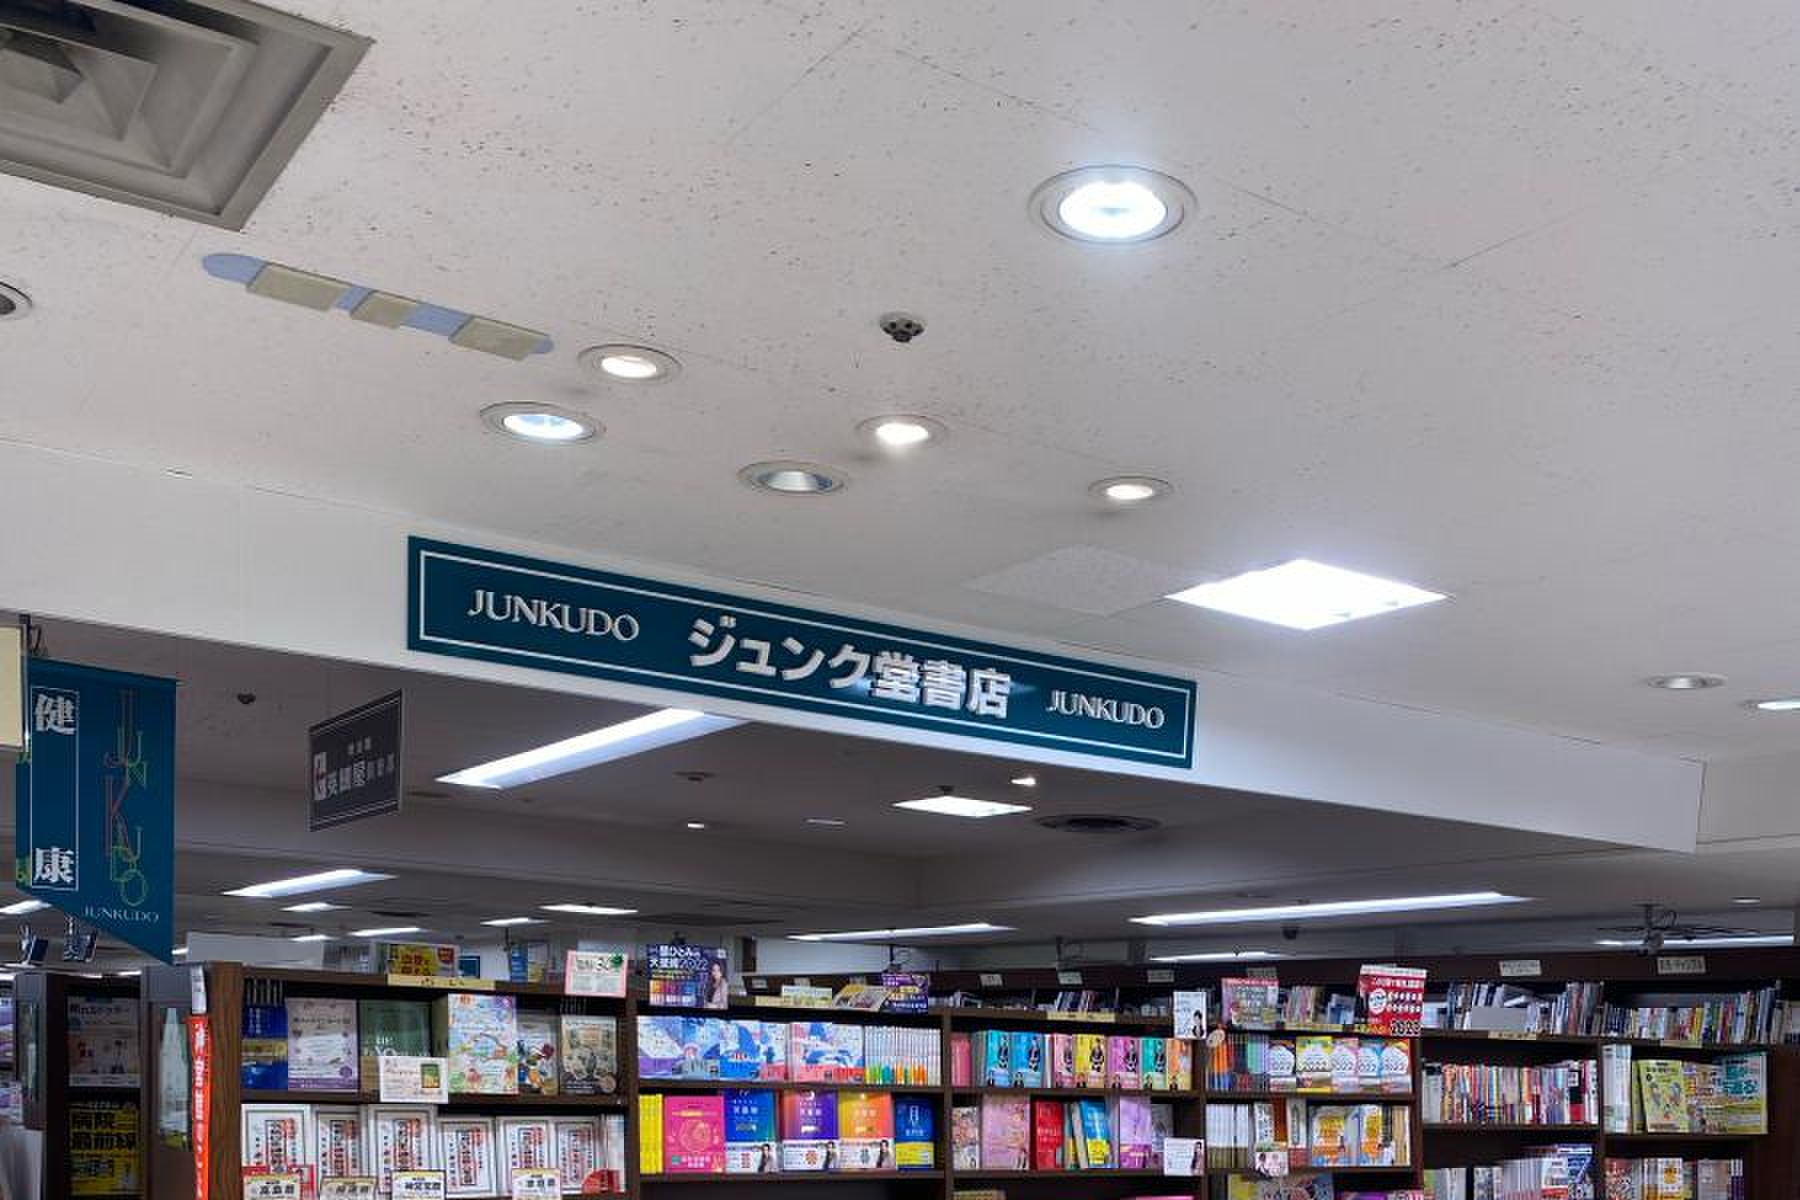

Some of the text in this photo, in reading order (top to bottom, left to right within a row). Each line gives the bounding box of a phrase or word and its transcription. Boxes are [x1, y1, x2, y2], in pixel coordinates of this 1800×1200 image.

[467, 589, 1166, 730] JUNKUDO ジュンク堂書店 JUNKUDO
[34, 693, 76, 884] 健康
[83, 904, 160, 924] JUNKUDO
